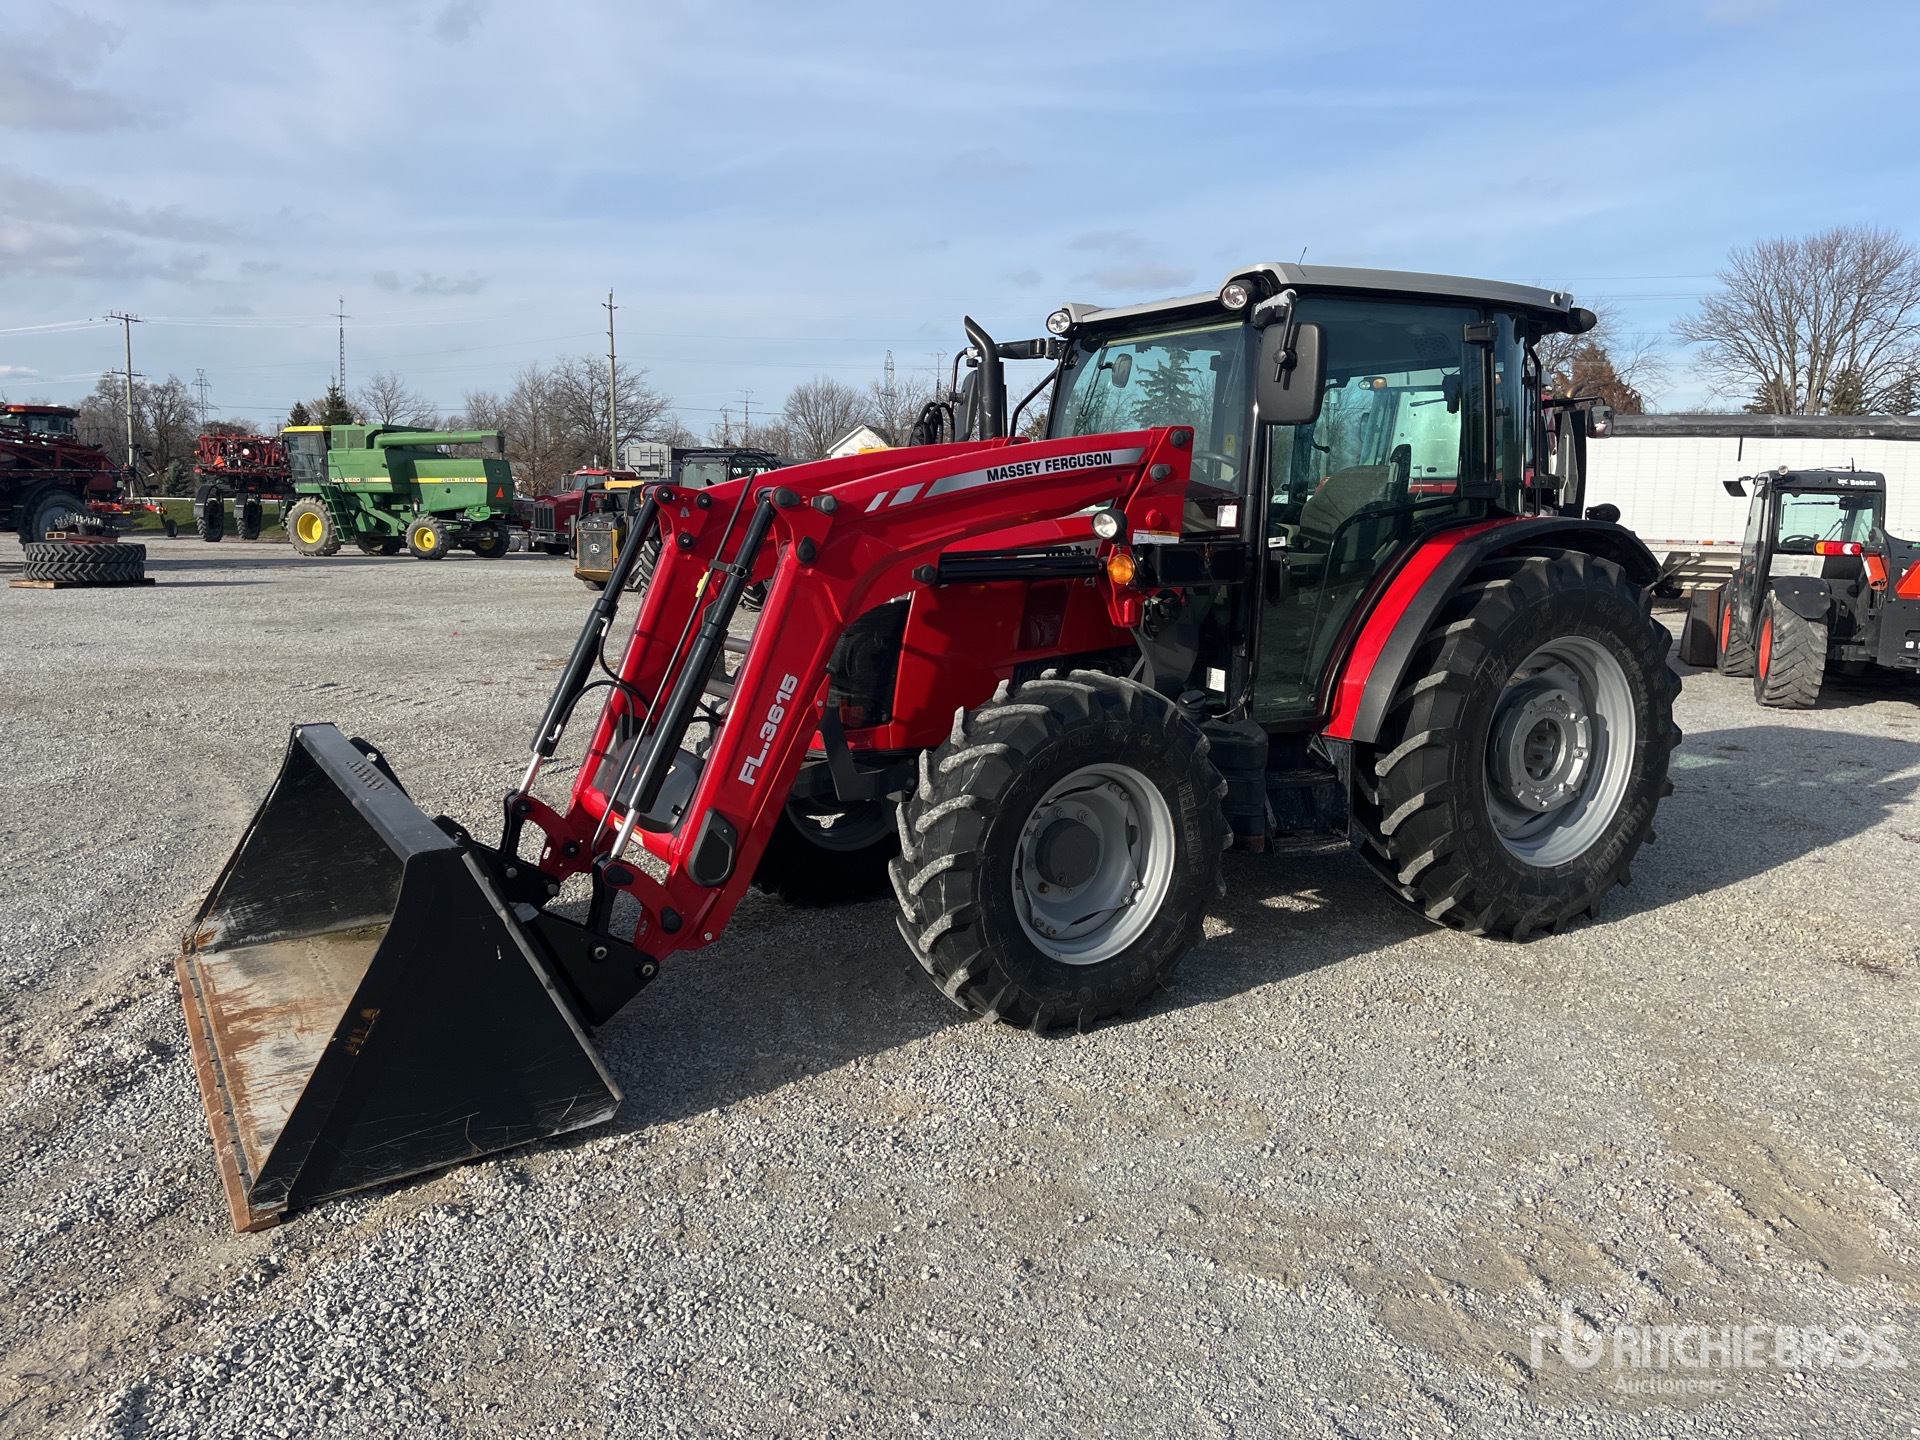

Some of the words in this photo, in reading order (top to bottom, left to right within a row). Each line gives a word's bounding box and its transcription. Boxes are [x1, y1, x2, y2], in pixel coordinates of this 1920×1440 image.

[986, 461, 1041, 482] MASSEY
[1045, 452, 1112, 473] FERGUSON
[1174, 769, 1205, 875] TRELLEBORG
[1584, 795, 1653, 896] TRELLEBORG
